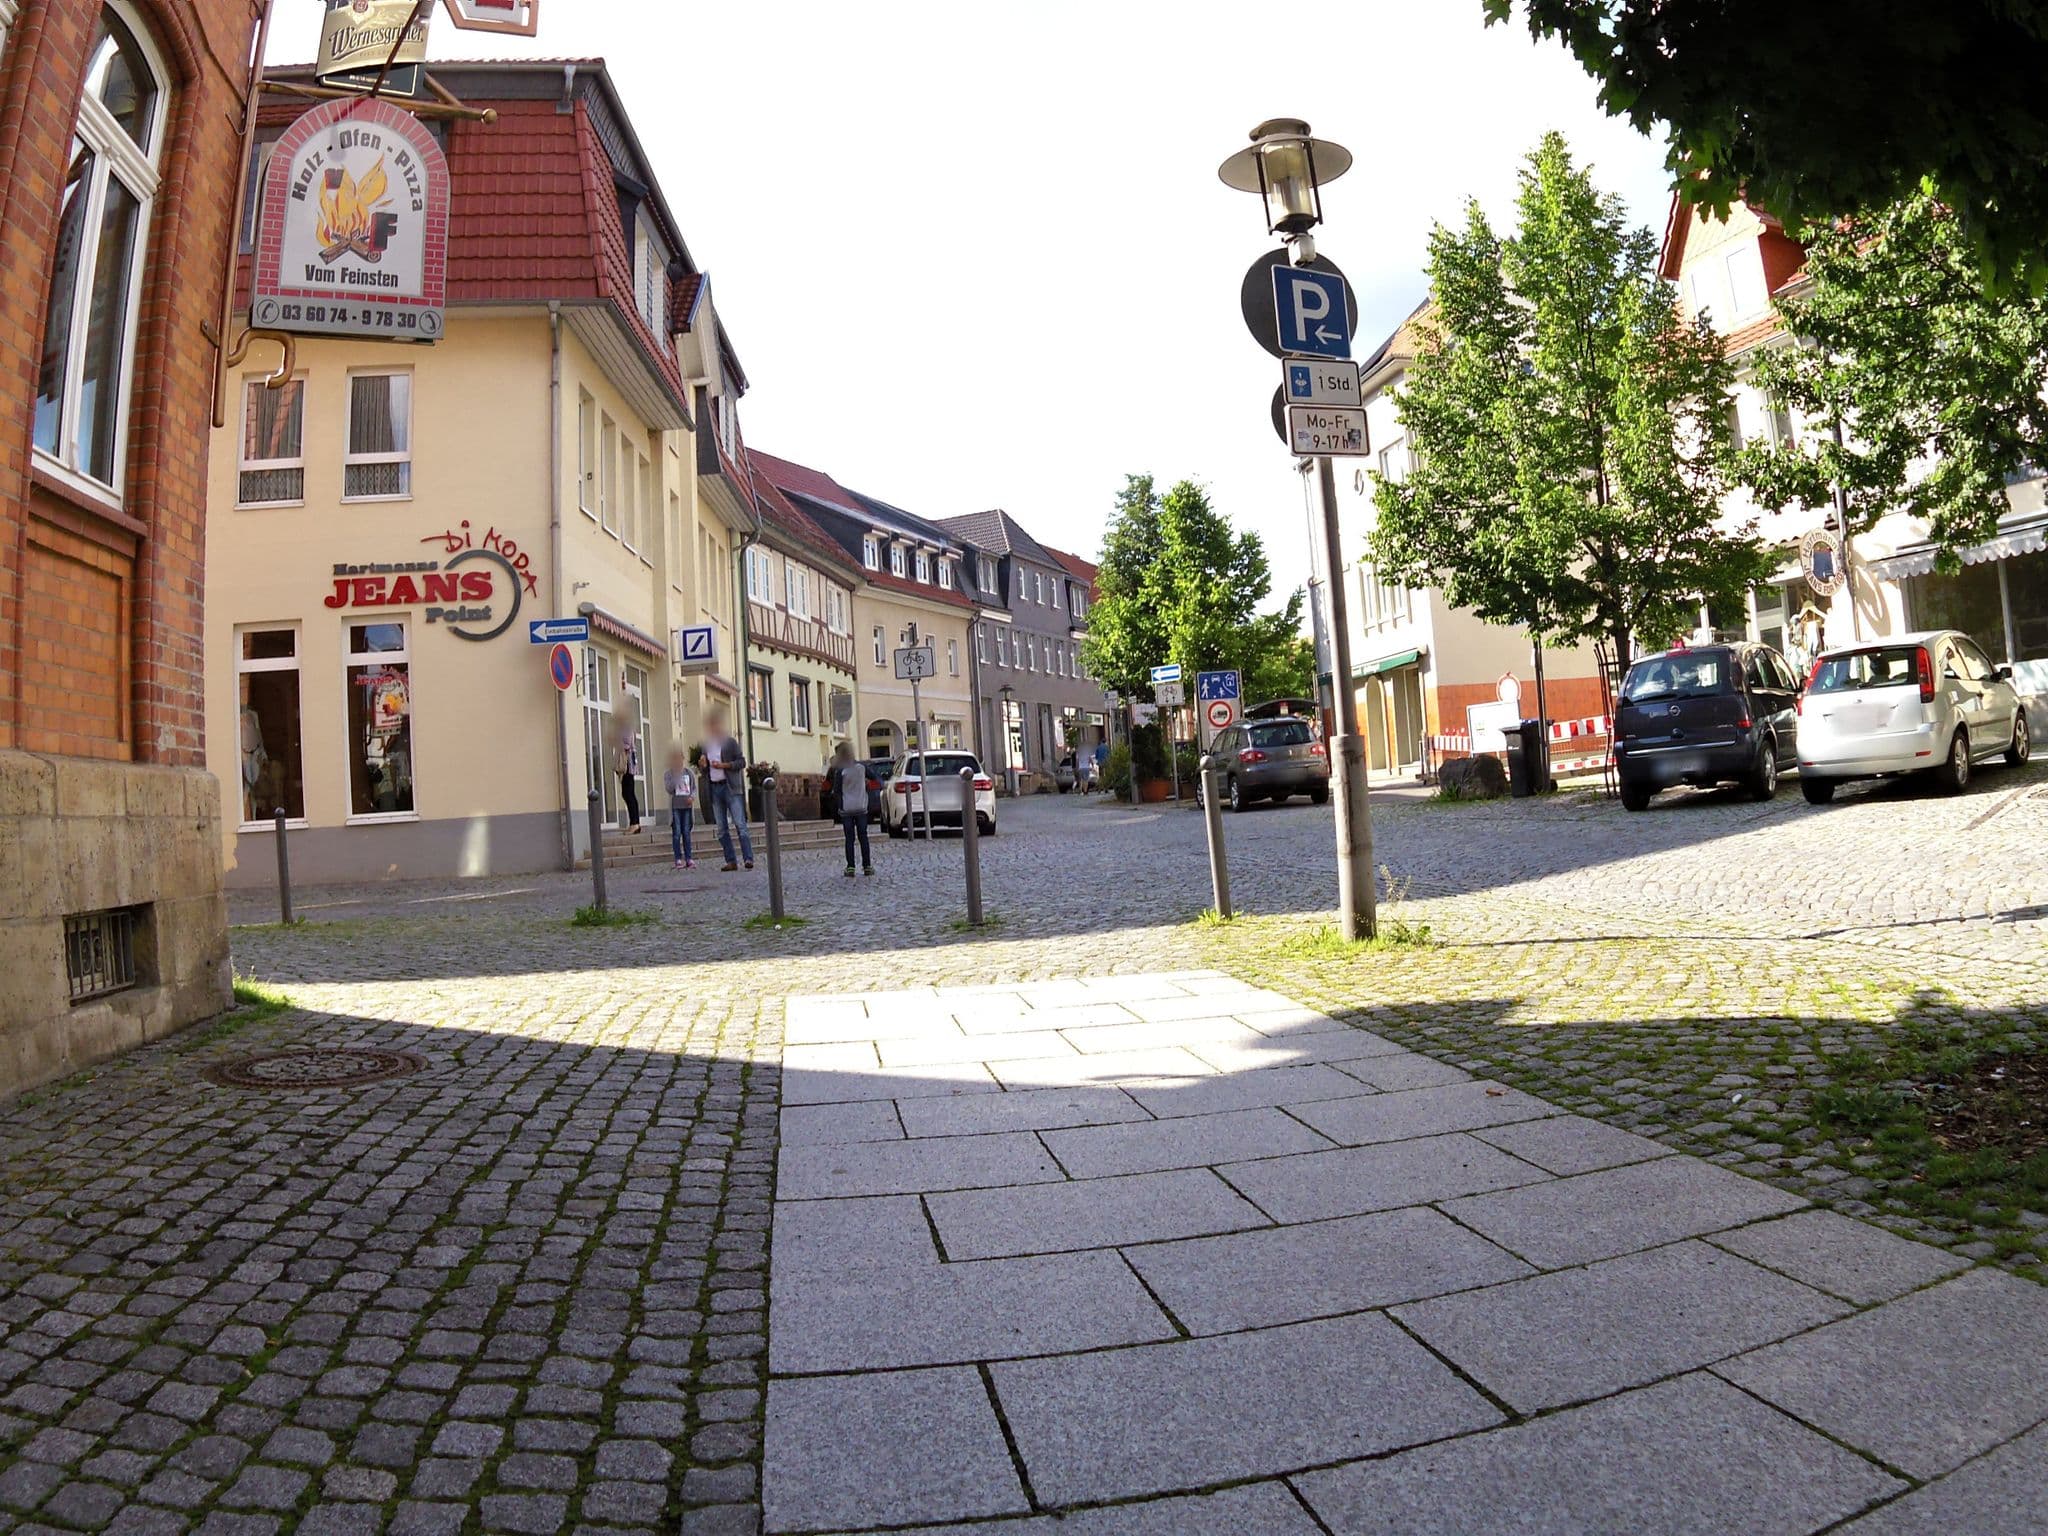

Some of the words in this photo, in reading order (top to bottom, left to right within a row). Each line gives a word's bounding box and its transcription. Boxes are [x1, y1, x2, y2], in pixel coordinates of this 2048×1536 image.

[292, 151, 324, 201] Holz
[339, 128, 381, 150] Ofen
[394, 149, 423, 212] Pizza
[369, 211, 398, 252] F
[305, 264, 335, 283] Vom
[341, 266, 398, 288] Feinsten
[282, 304, 301, 321] 03
[306, 306, 326, 322] 60
[330, 307, 347, 323] 74
[361, 310, 372, 325] 9
[376, 311, 393, 327] 78
[397, 312, 416, 328] 30
[1291, 278, 1330, 342] P
[1328, 376, 1353, 391] Std.
[1306, 414, 1350, 429] Mo-Fr
[1312, 434, 1340, 449] 9-17
[333, 560, 438, 576] Hartmanns
[324, 571, 493, 608] JEANS
[425, 605, 492, 624] Point
